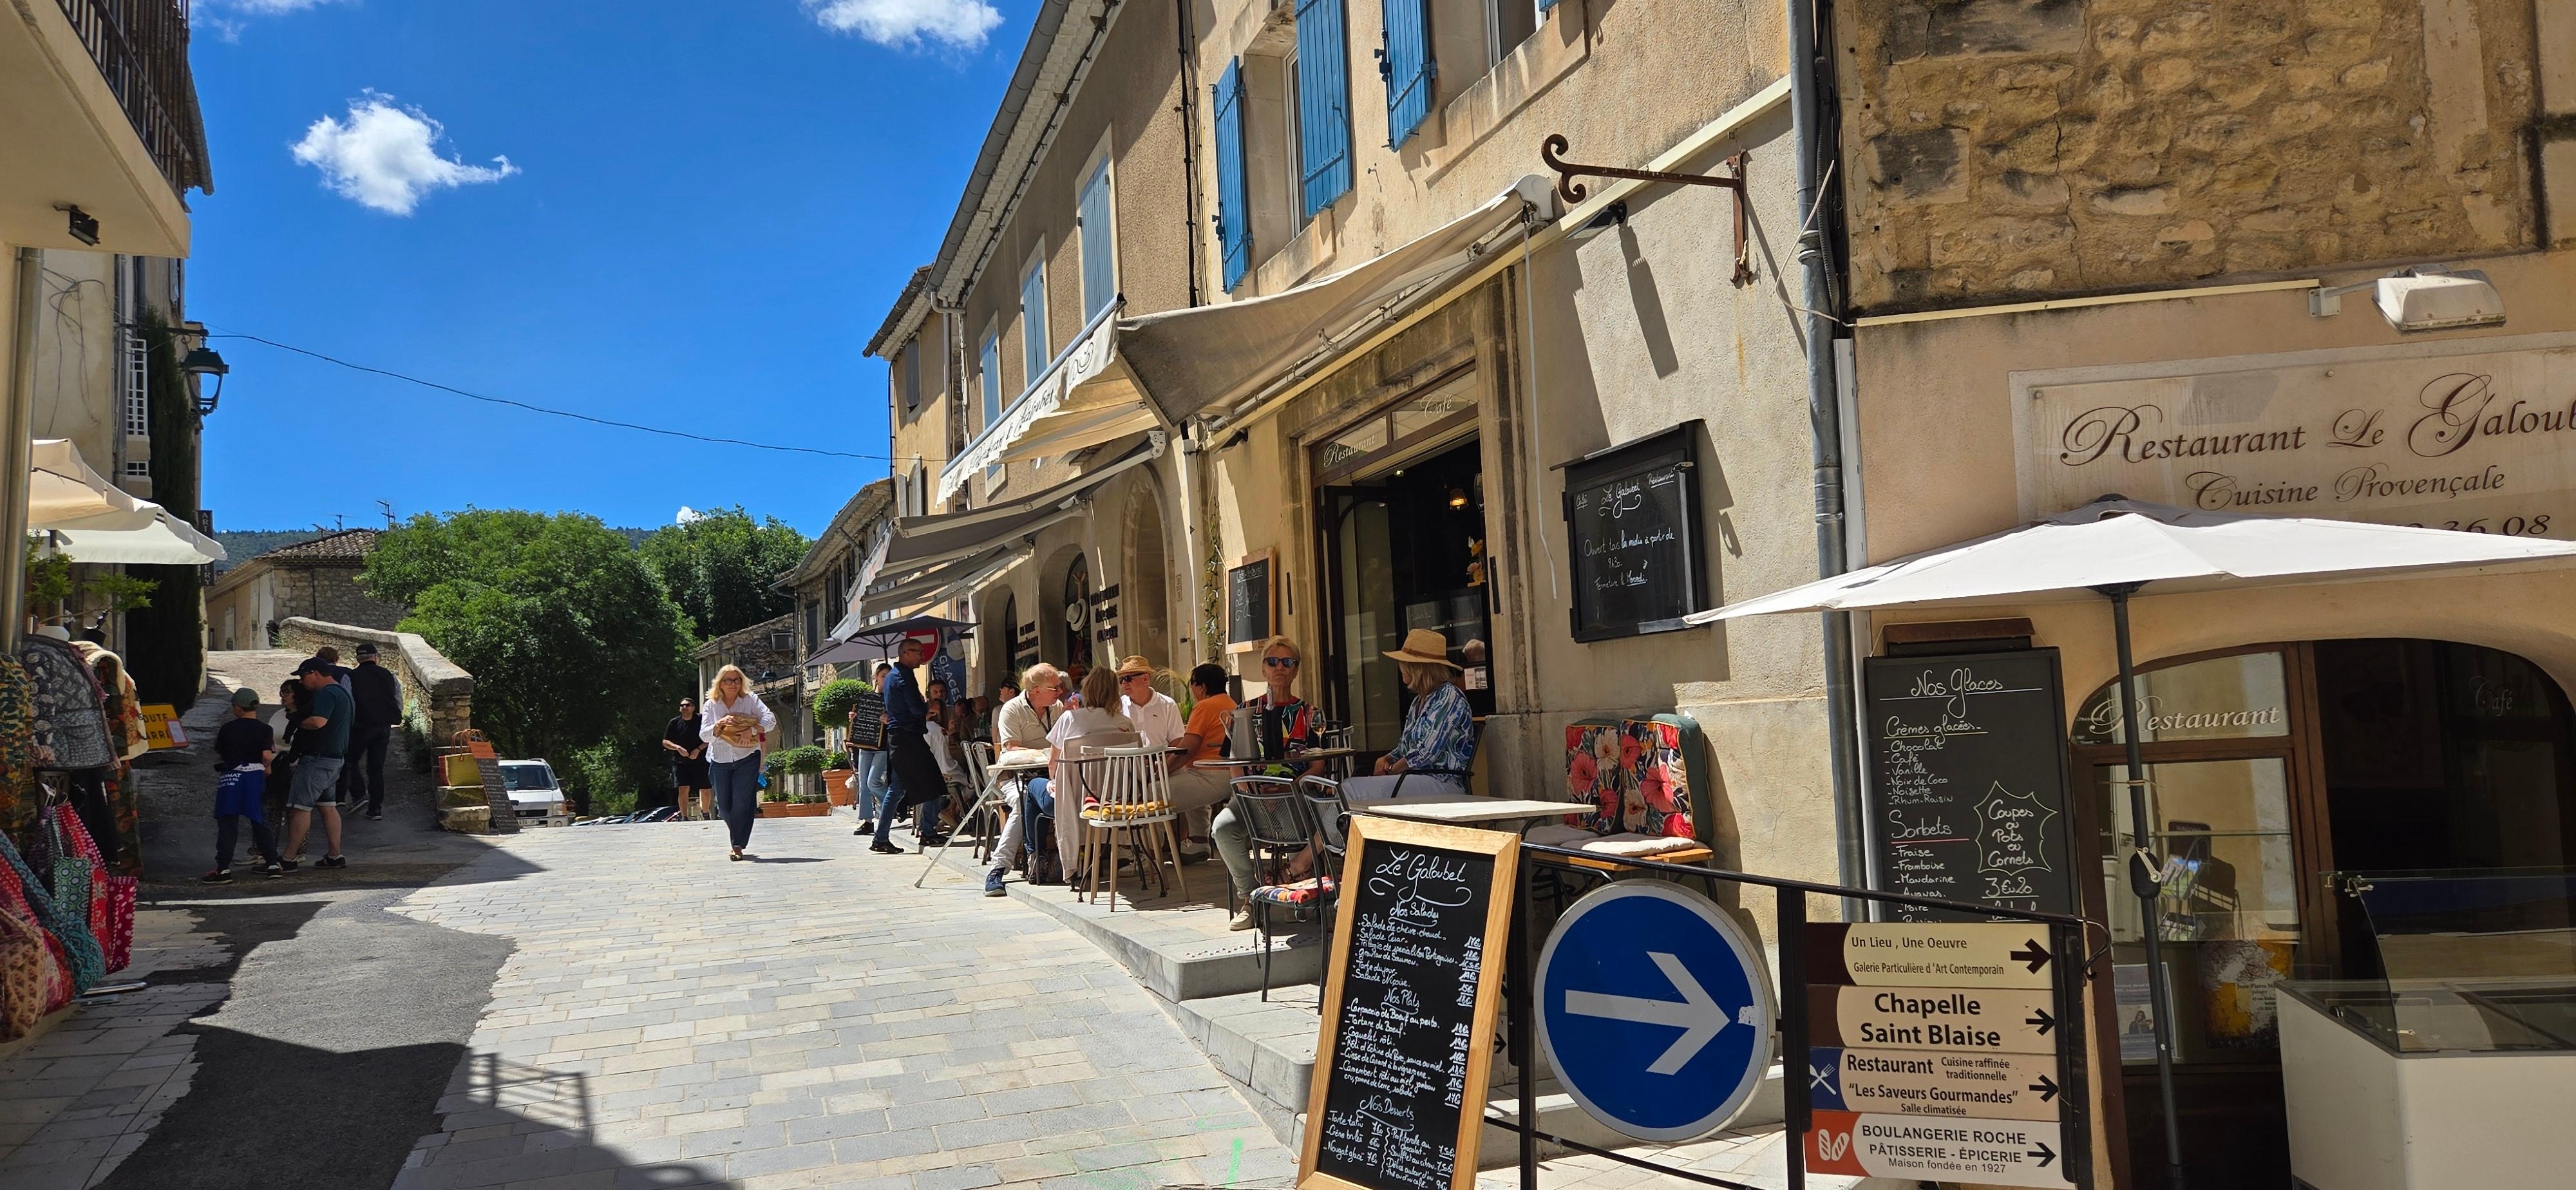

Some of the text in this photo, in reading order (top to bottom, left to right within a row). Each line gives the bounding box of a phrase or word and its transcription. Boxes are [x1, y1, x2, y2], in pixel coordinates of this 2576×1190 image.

[1420, 394, 1452, 419] Café
[2061, 404, 2306, 466] Restaurant
[2325, 409, 2385, 448] Le
[1323, 433, 1376, 468] Restaurant
[2186, 462, 2505, 511] Cuisine Provençale
[2502, 515, 2552, 536] 08
[939, 655, 963, 703] GLACES
[1910, 670, 1947, 697] Nos
[2469, 675, 2514, 716] Café
[2088, 695, 2282, 735] Restaurant
[1886, 715, 1930, 737] Crèmes
[1891, 739, 1944, 753] Chocolat
[1891, 751, 1919, 766] Café
[1892, 762, 1928, 776] Vanille
[1891, 773, 1948, 786] Noix de Coco
[1893, 786, 1933, 796] Noisette
[1988, 799, 2034, 821] Coupes
[1889, 809, 1952, 839] Sorbets
[1991, 829, 2023, 843] Pots
[1896, 844, 1934, 857] Fraise
[1987, 850, 2034, 867] Cornets
[1898, 858, 1945, 871] Framboise
[1376, 846, 1466, 902] Le Galoubet
[1900, 873, 1956, 883] Mandarine
[1390, 900, 1439, 919] Nos Salades
[1361, 913, 1386, 930] Salade
[1360, 927, 1386, 940] Salade
[1851, 936, 1967, 949] Un Lieu Une Oeuvre
[1355, 968, 1381, 982] Salade
[1853, 961, 1880, 974] Galerie
[1881, 962, 1924, 974] Particulière
[1949, 964, 2004, 978] Contemporain
[1384, 988, 1399, 1004] Nos
[1874, 992, 1982, 1019] Chapelle
[1860, 1023, 2001, 1047] Saint Blaise
[1847, 1054, 2010, 1075] Restaurant Cuisine raffinée
[1946, 1069, 2007, 1081] traditionnelle
[1877, 1084, 1927, 1100] Saveurs
[1359, 1095, 1415, 1120] Nos Desserts
[1900, 1103, 1967, 1116] Salle climatisée
[1862, 1125, 2027, 1145] BOULANGERIE ROCHE
[1869, 1142, 2022, 1163] PÂTISSERIE ÉPICERIE
[1888, 1157, 2006, 1173] Maison fondée en 1927
